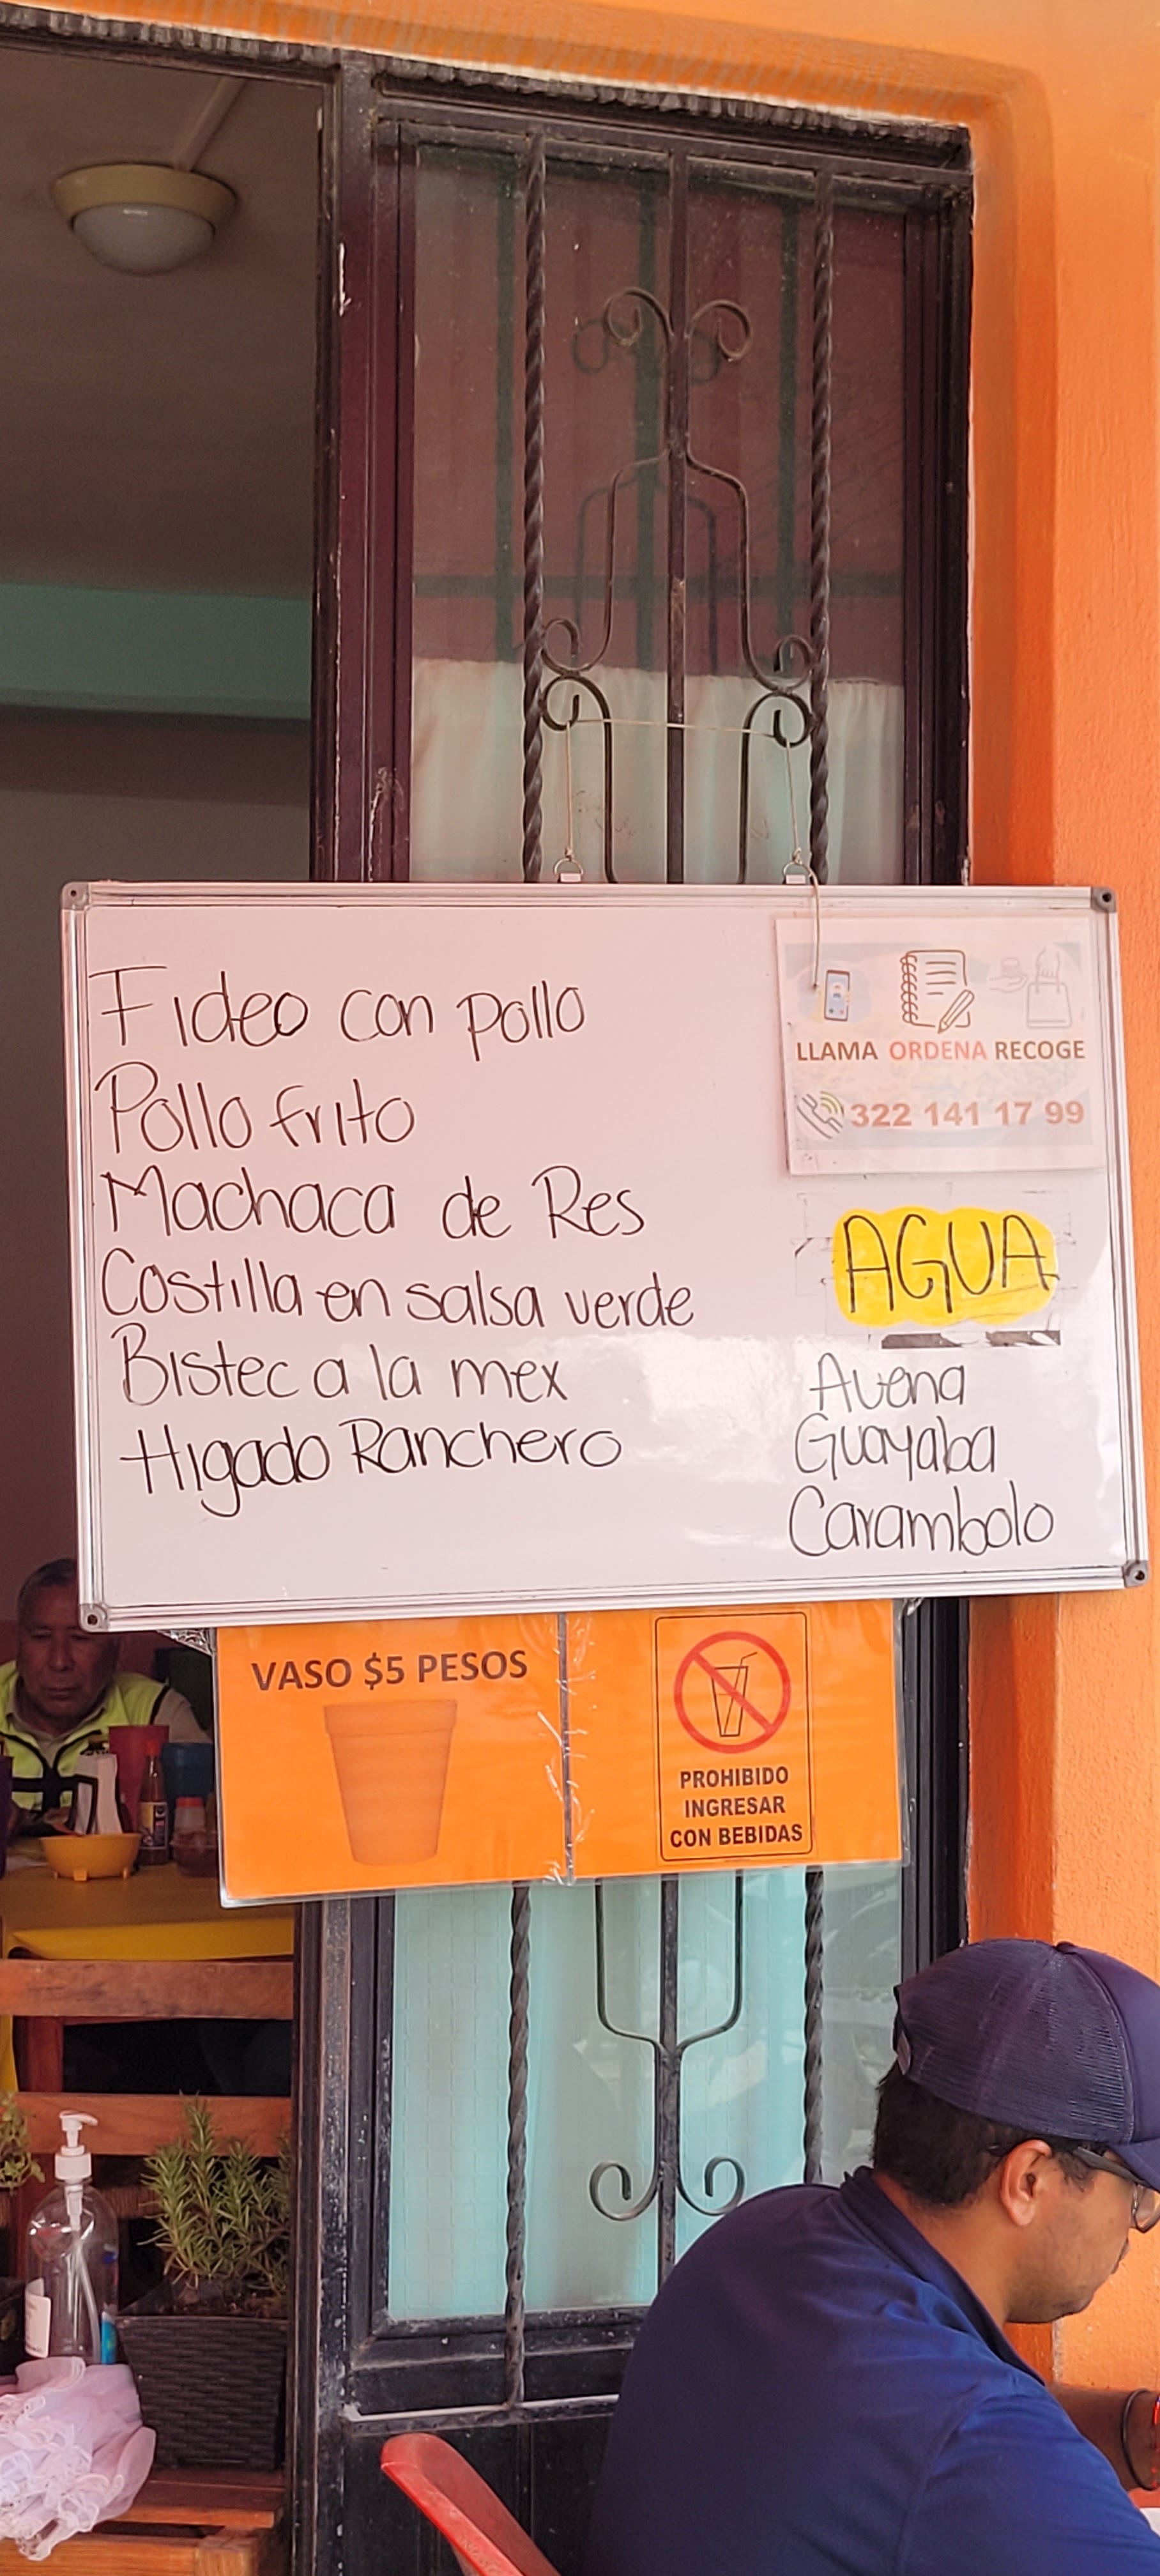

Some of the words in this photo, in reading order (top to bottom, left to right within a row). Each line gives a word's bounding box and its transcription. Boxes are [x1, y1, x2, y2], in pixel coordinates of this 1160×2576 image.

[88, 965, 309, 1048] Fideo
[340, 989, 434, 1042] con
[455, 980, 586, 1062] pollo
[797, 1041, 878, 1061] LLAMA
[889, 1041, 988, 1060] ORDENA
[995, 1040, 1085, 1059] RECOGE
[94, 1061, 252, 1154] Pollo
[270, 1078, 415, 1147] frito
[851, 1103, 912, 1127] 322
[924, 1102, 979, 1126] 141
[995, 1101, 1032, 1125] 17
[1044, 1100, 1085, 1124] 99
[100, 1165, 395, 1237] Machaca
[441, 1176, 512, 1239] de
[531, 1165, 645, 1238] Res
[101, 1248, 303, 1316] Costilla
[315, 1278, 390, 1322] en
[405, 1270, 546, 1328] salsa
[565, 1271, 695, 1329] verde
[843, 1213, 1060, 1314] AGUA
[111, 1322, 300, 1406] Bistec
[313, 1358, 349, 1397] a
[369, 1344, 422, 1400] la
[451, 1358, 569, 1403] mex
[809, 1352, 965, 1413] Avena
[119, 1423, 330, 1517] Higado
[339, 1418, 622, 1474] Ranchero
[795, 1413, 995, 1481] Guayaba
[789, 1480, 1055, 1556] Carambolo
[251, 1659, 353, 1691] VASO
[363, 1652, 405, 1690] $5
[419, 1650, 528, 1683] PESOS
[680, 1765, 790, 1788] PROHIBIDO
[685, 1795, 786, 1818] INGRESAR
[669, 1827, 714, 1848] CON
[718, 1821, 804, 1846] BEBIDAS
